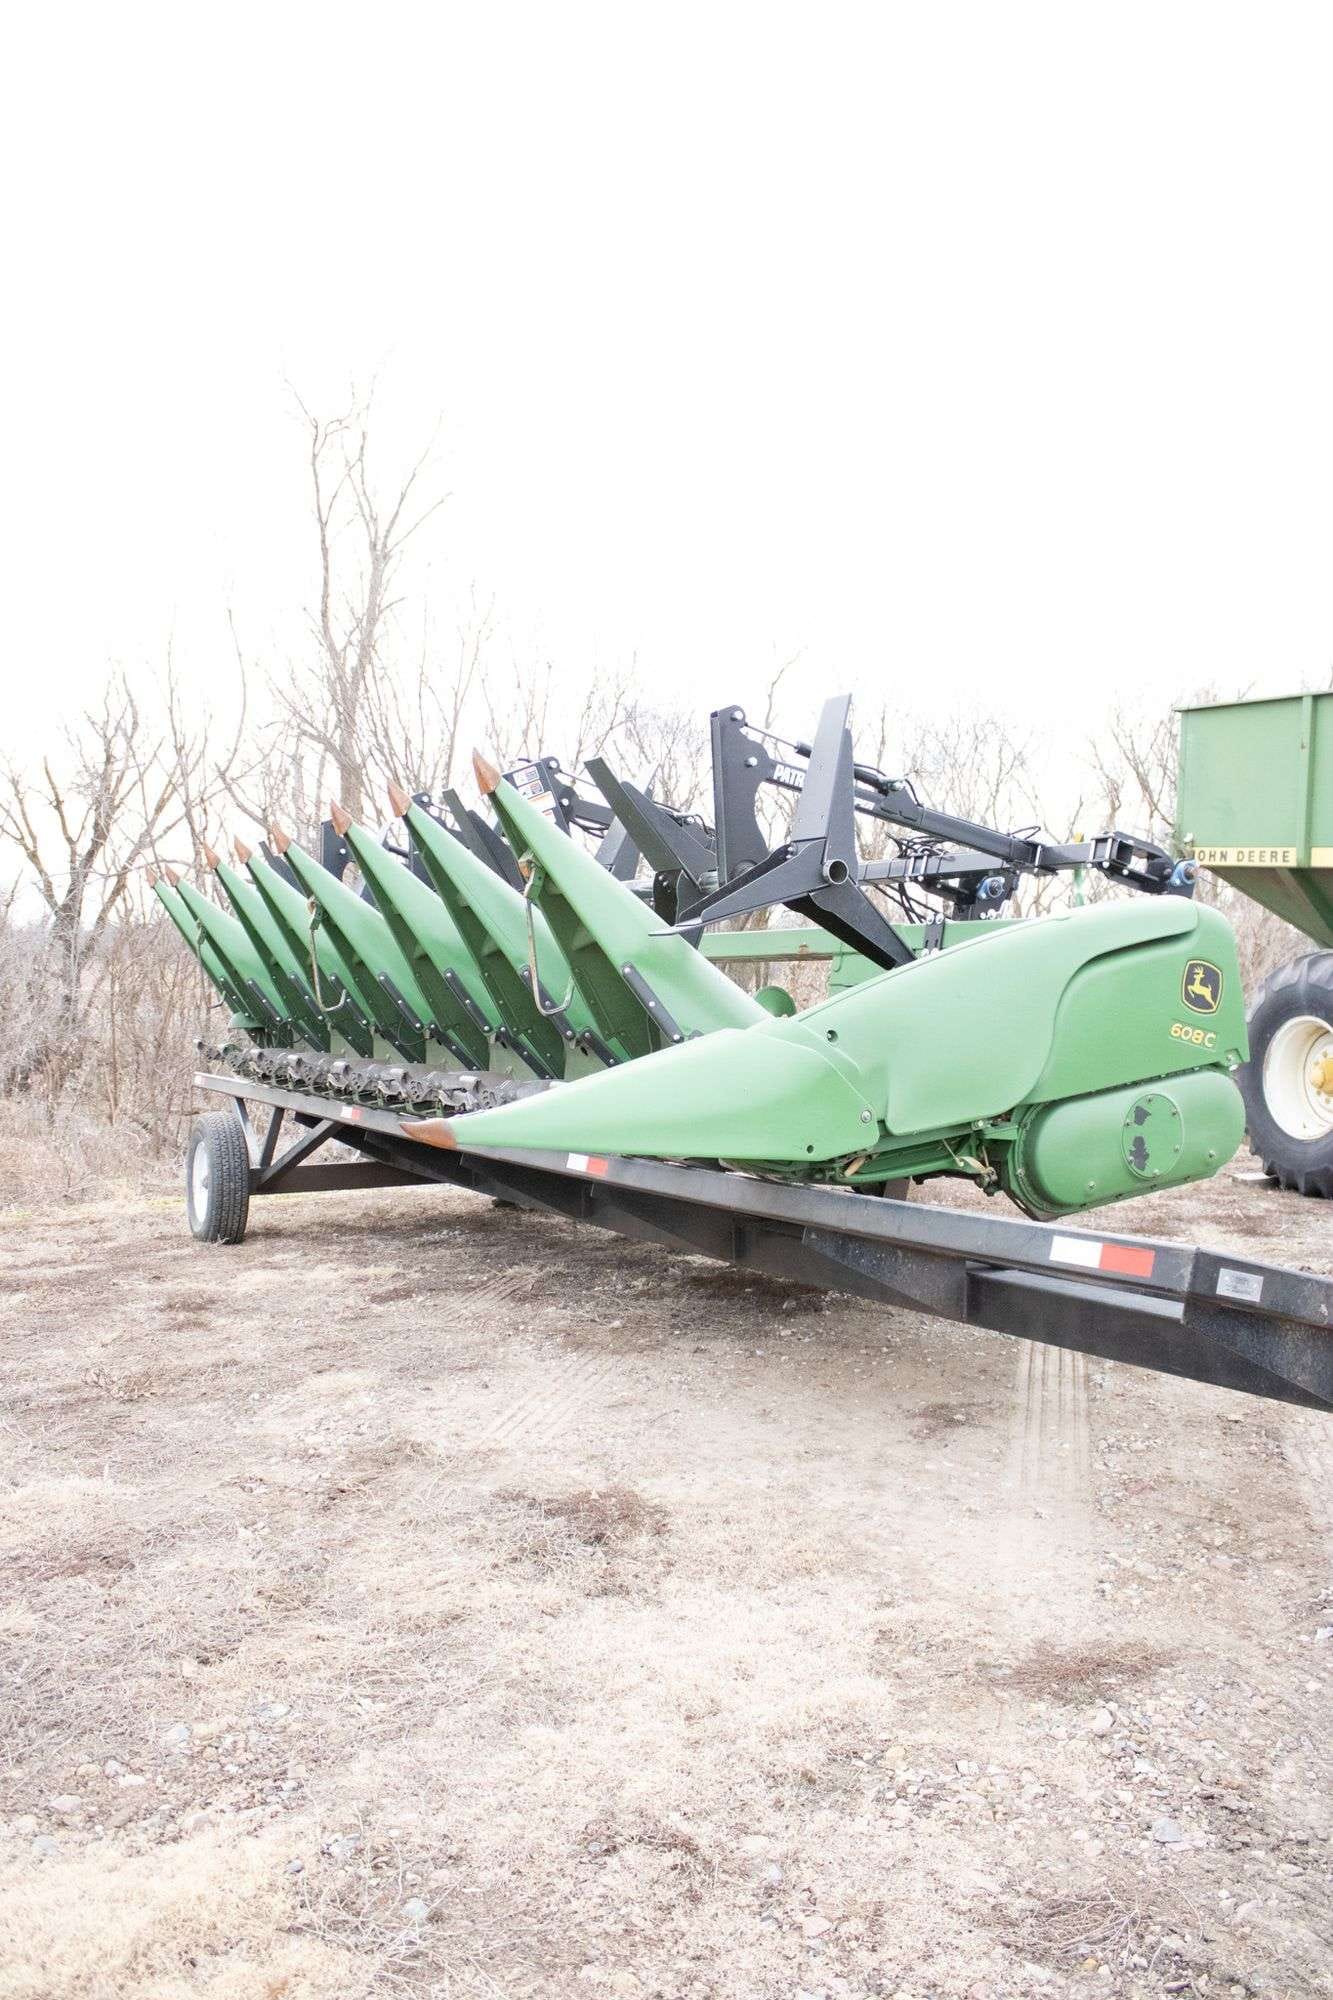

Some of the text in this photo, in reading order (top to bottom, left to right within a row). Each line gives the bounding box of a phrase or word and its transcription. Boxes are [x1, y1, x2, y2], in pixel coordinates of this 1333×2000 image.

[773, 764, 806, 788] PATR
[1236, 850, 1290, 863] DEERE
[1170, 1023, 1217, 1048] 608C
